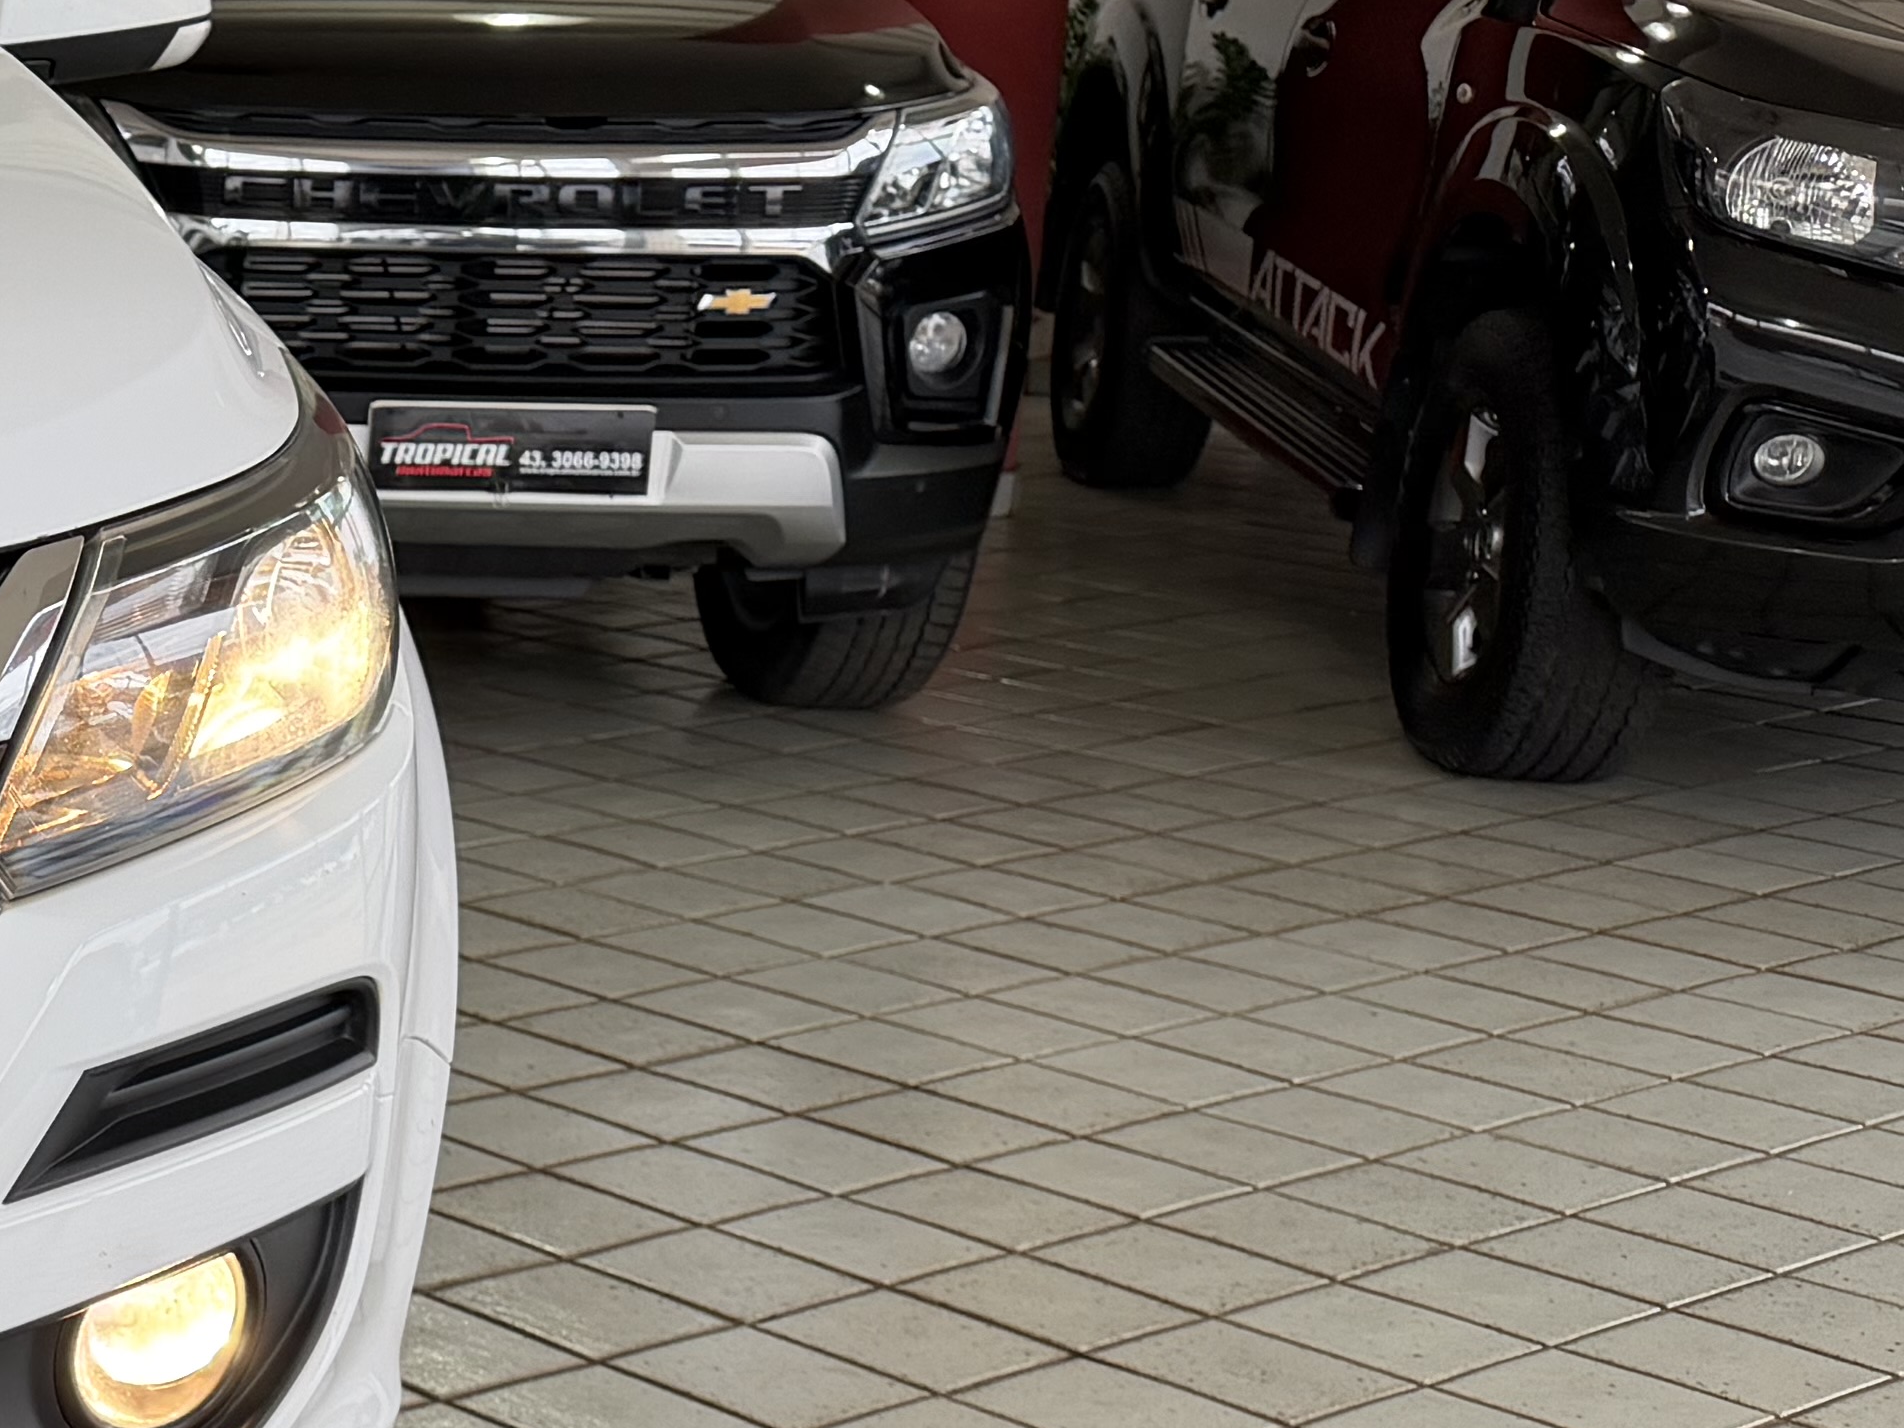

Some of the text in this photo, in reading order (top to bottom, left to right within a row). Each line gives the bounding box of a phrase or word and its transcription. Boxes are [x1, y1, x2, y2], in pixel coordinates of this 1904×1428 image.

[223, 175, 804, 219] CHEVROLET
[1249, 248, 1387, 390] ATTACK
[379, 441, 512, 467] TROPICAL
